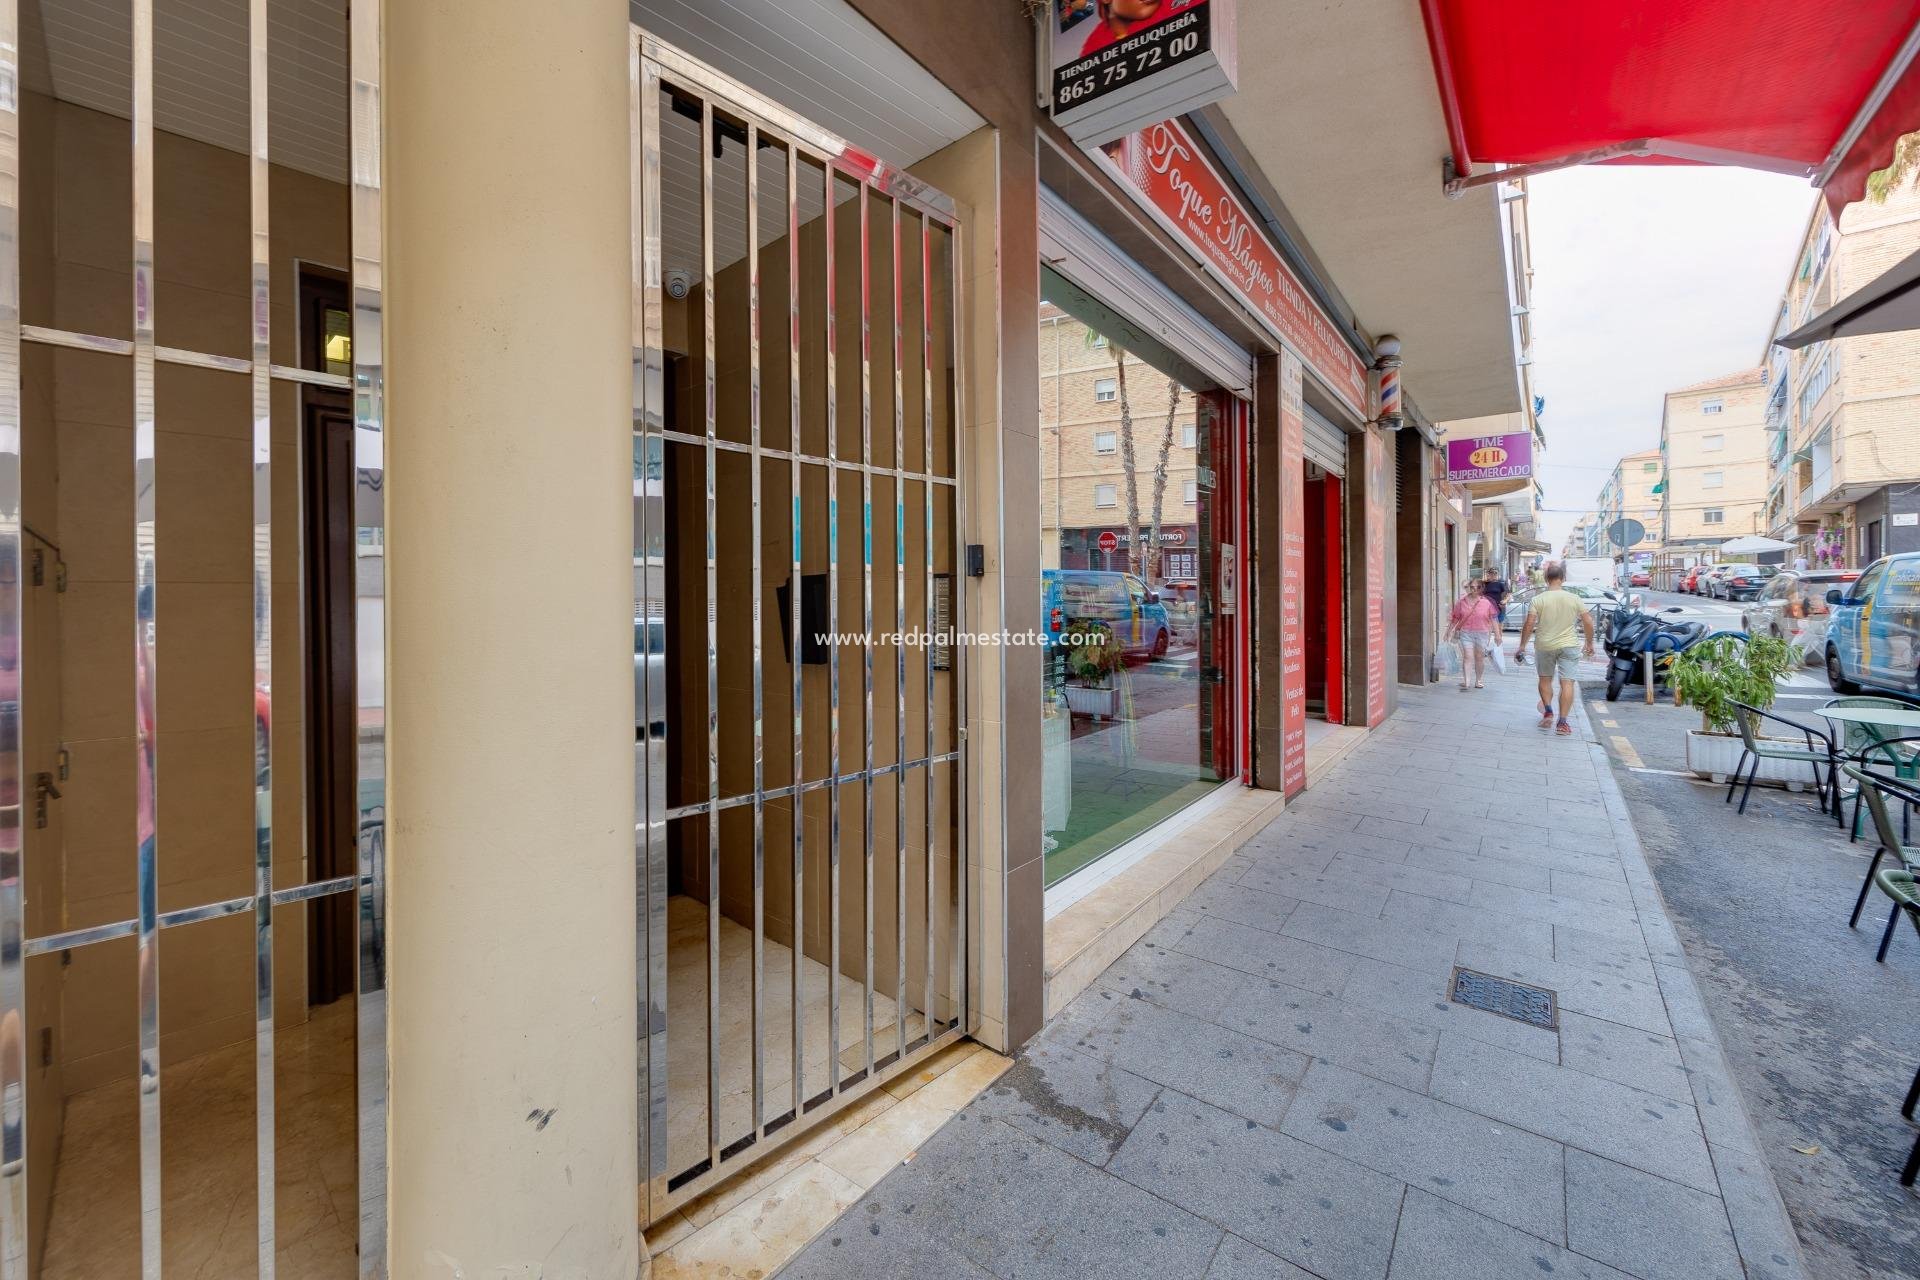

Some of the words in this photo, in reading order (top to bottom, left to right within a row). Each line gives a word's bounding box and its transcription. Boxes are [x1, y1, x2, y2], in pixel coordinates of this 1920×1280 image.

[1059, 58, 1100, 81] TIENDA
[1102, 47, 1119, 62] DE
[1121, 12, 1198, 54] PELUQUERÍA
[1059, 75, 1096, 104] 865
[1103, 61, 1128, 86] 75
[1136, 47, 1161, 72] 72
[1169, 31, 1199, 58] 00
[1147, 123, 1212, 225] Toque
[1277, 268, 1307, 320] TIENDA
[1473, 436, 1503, 448] TIME
[1474, 451, 1488, 464] 24
[1449, 464, 1530, 480] SUPERMERCADO
